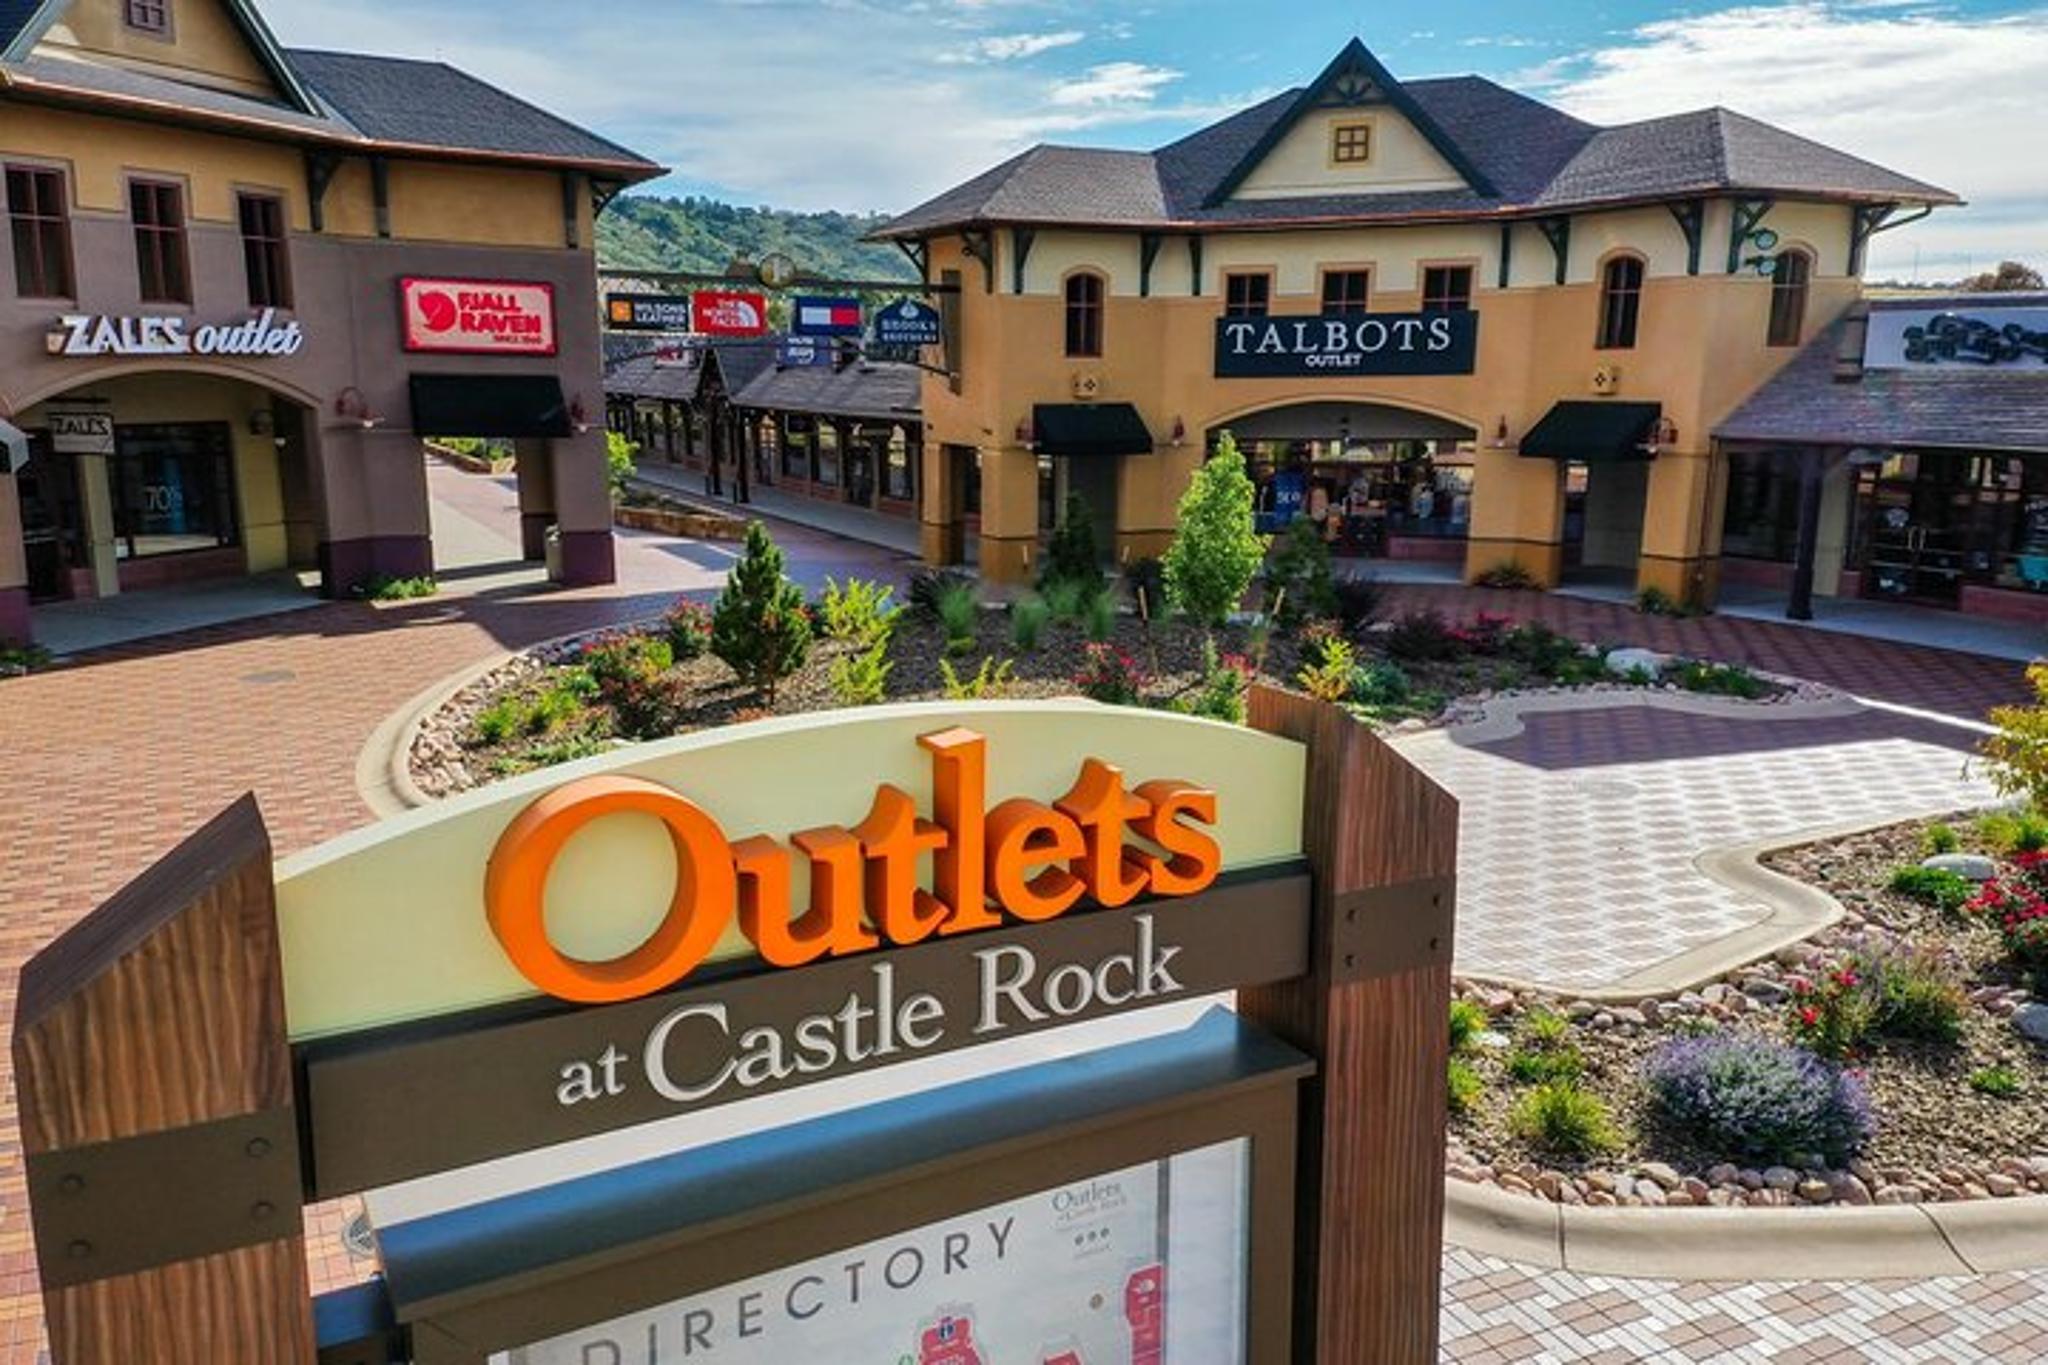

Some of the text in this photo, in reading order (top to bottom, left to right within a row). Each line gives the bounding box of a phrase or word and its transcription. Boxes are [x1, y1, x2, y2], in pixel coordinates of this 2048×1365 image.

[63, 307, 302, 354] ZALES outlet
[702, 308, 739, 317] NORTH
[711, 314, 740, 327] FACE
[1225, 318, 1451, 354] TALBOTS
[1305, 353, 1363, 368] OUTLET
[484, 726, 1222, 1004] Outlets
[556, 914, 1185, 1108] at Castle Rock
[581, 1217, 1015, 1365] DIRECTORY
